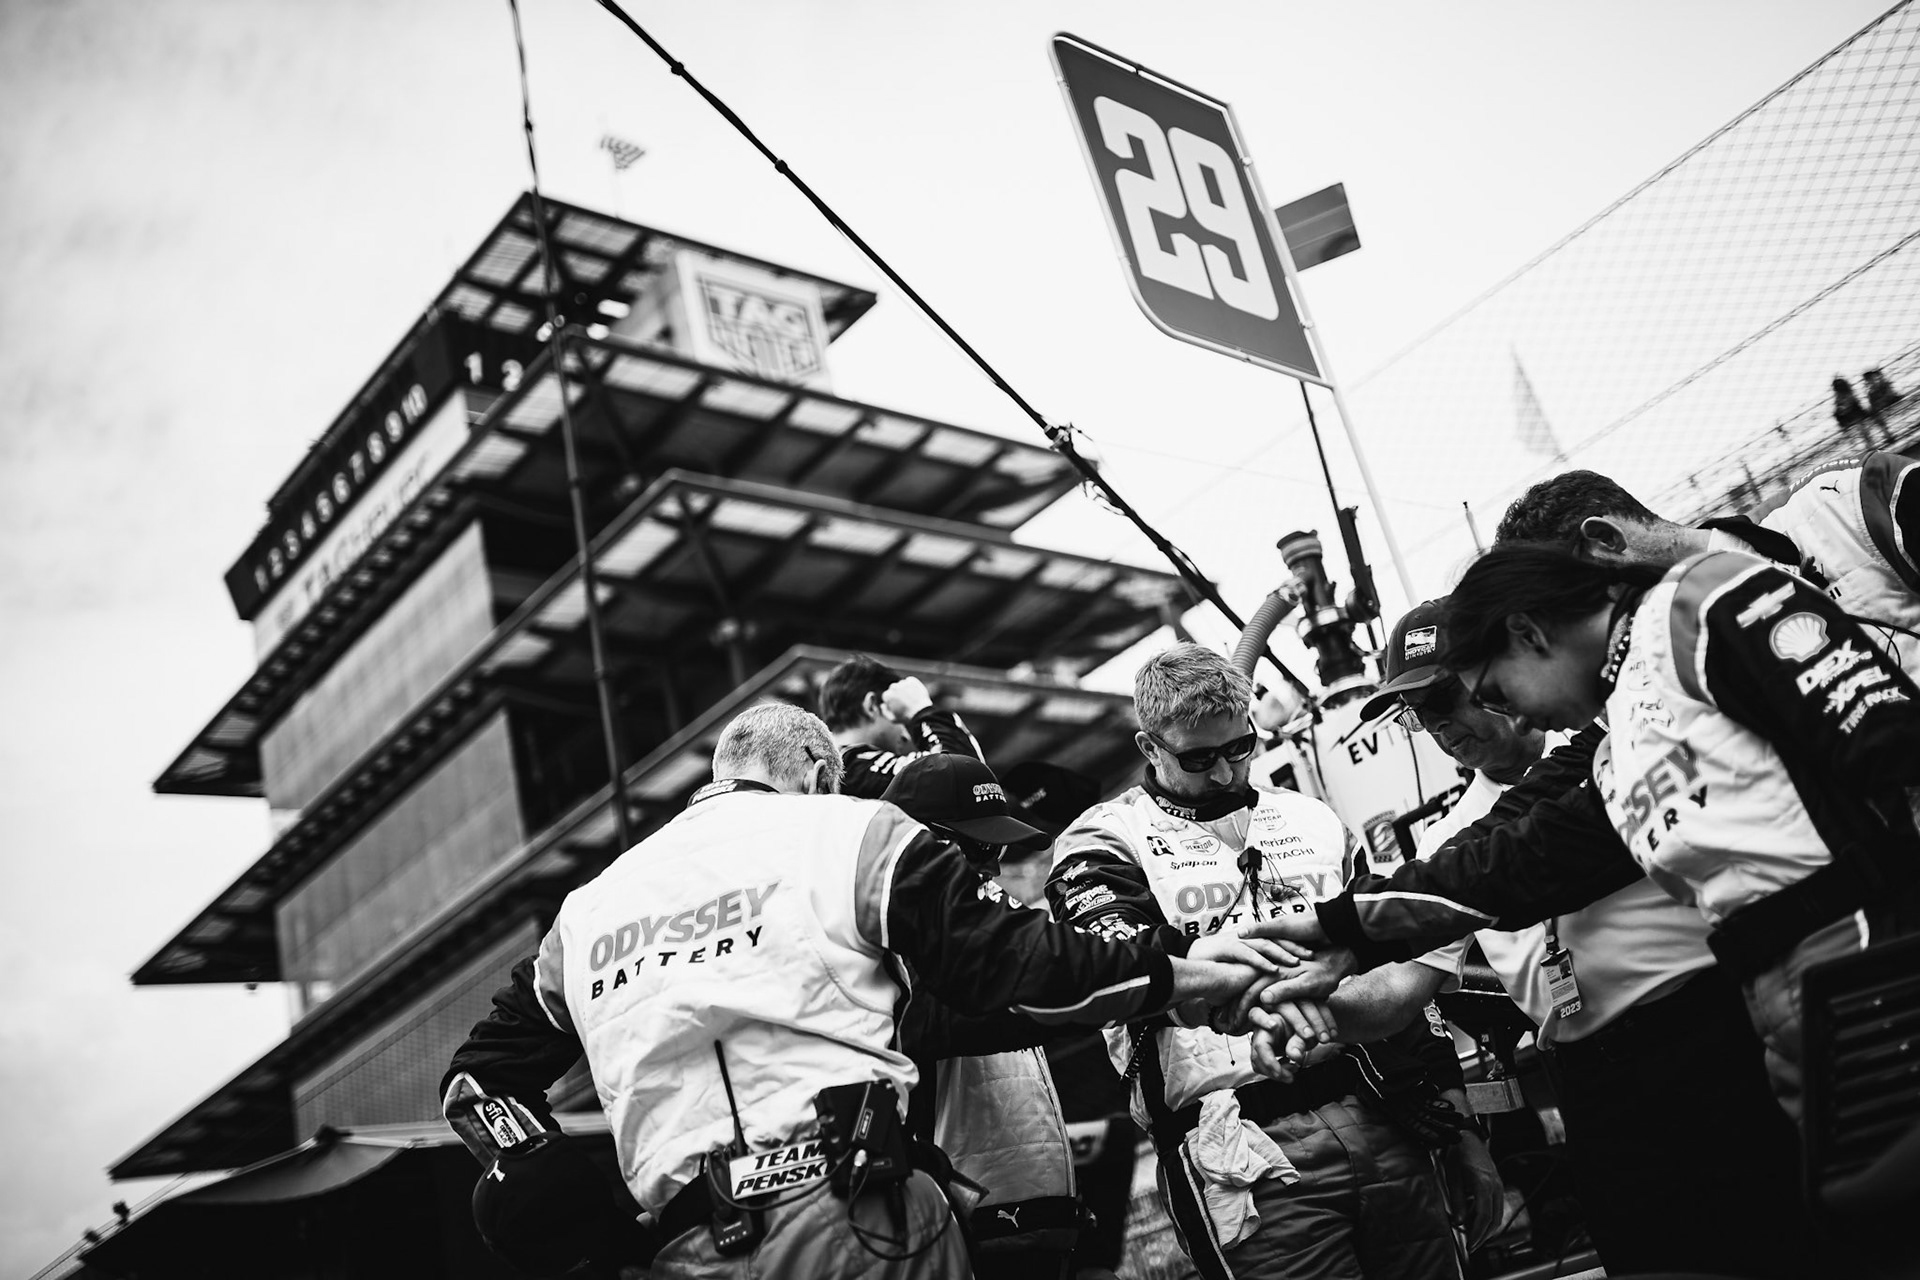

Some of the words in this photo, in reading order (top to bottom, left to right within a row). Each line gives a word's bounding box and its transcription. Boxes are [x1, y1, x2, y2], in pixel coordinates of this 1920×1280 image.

[1093, 95, 1280, 322] 29
[1795, 638, 1861, 696] DEX
[1827, 665, 1892, 715] XPEL
[1838, 699, 1869, 734] TIRE
[588, 879, 783, 973] ODYSSEY
[590, 925, 763, 1001] BATTERY
[1560, 1001, 1582, 1019] 2023
[485, 1102, 504, 1120] sfi
[754, 1140, 828, 1170] TEAM
[734, 1162, 829, 1197] PENSK
